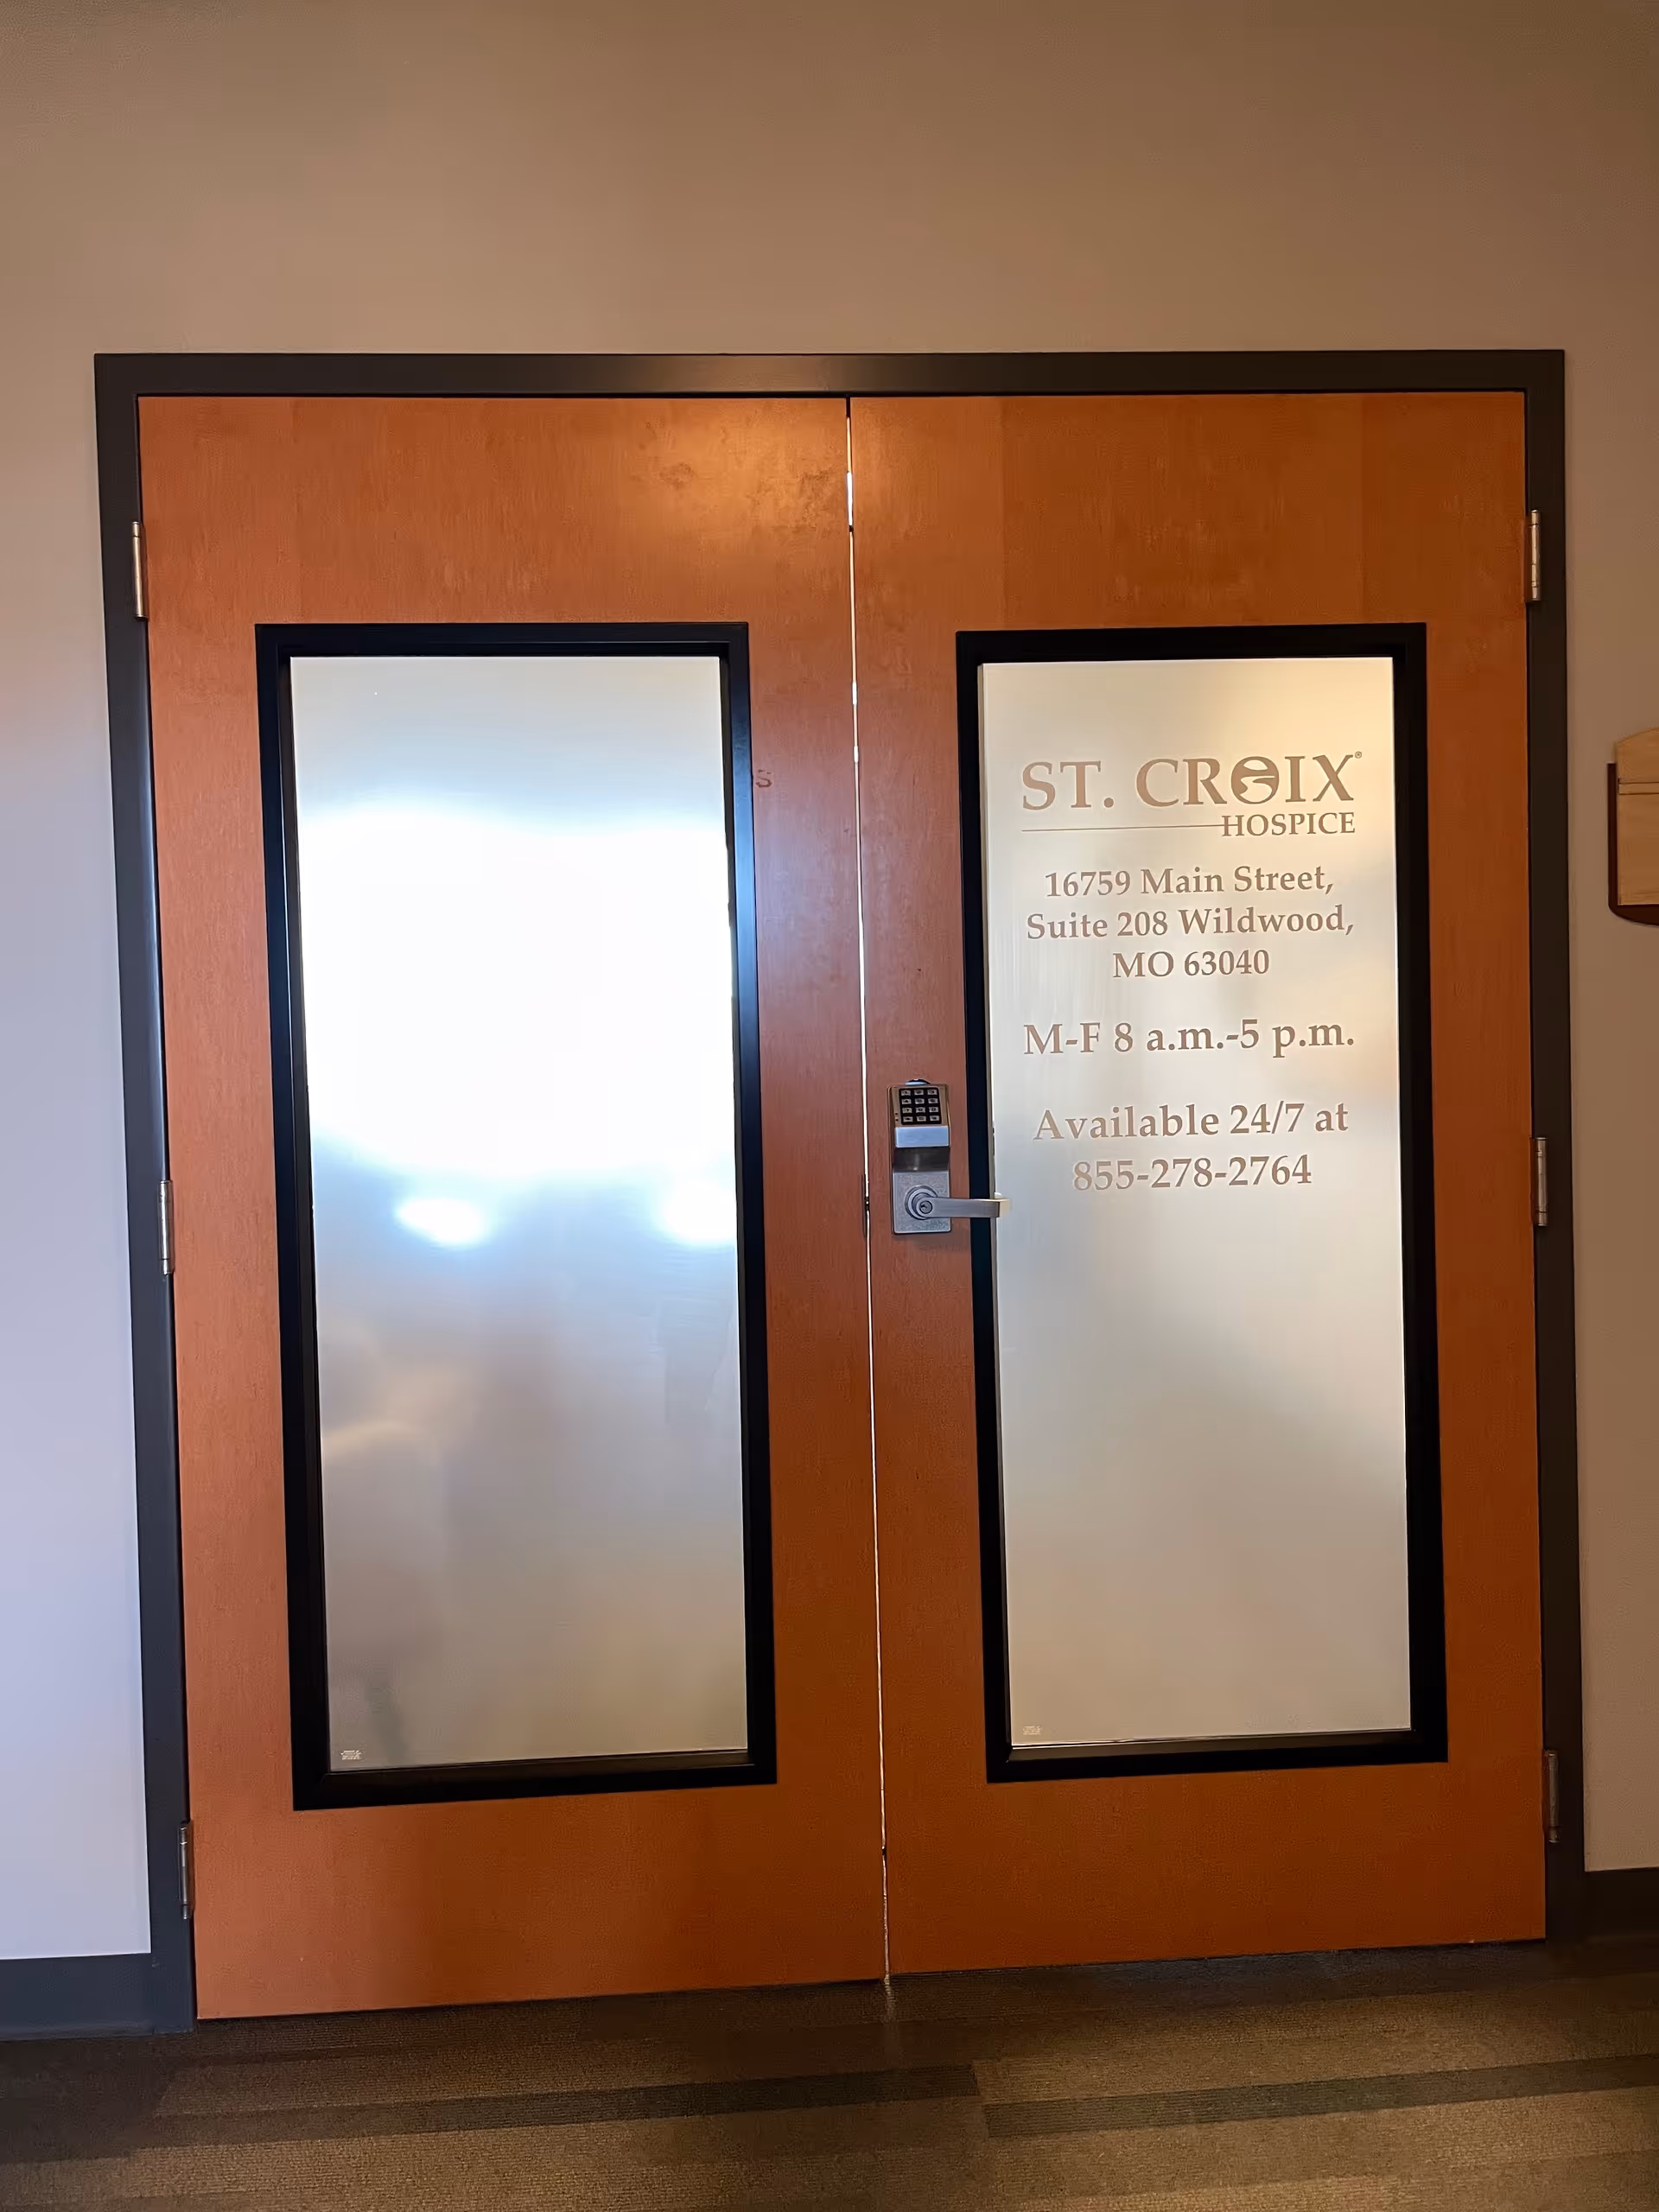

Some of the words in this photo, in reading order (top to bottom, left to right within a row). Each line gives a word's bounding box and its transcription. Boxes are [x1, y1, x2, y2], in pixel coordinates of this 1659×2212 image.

[1022, 760, 1115, 810] ST.
[1221, 811, 1356, 837] HOSPICE
[1045, 870, 1131, 898] 16759
[1140, 866, 1225, 894] Main
[1234, 865, 1334, 895] Street,
[1027, 912, 1109, 940] Suite
[1116, 911, 1168, 937] 208
[1178, 903, 1354, 936] Wildwood,
[1112, 950, 1174, 978] MO
[1184, 949, 1270, 976] 63040
[1023, 1021, 1101, 1055] M-F
[1114, 1021, 1134, 1052] 8
[1271, 1024, 1354, 1058] p.m.
[1033, 1103, 1219, 1141] Available
[1230, 1100, 1306, 1135] 24/7
[1315, 1103, 1349, 1132] at
[1071, 1154, 1313, 1192] 855-278-2764
